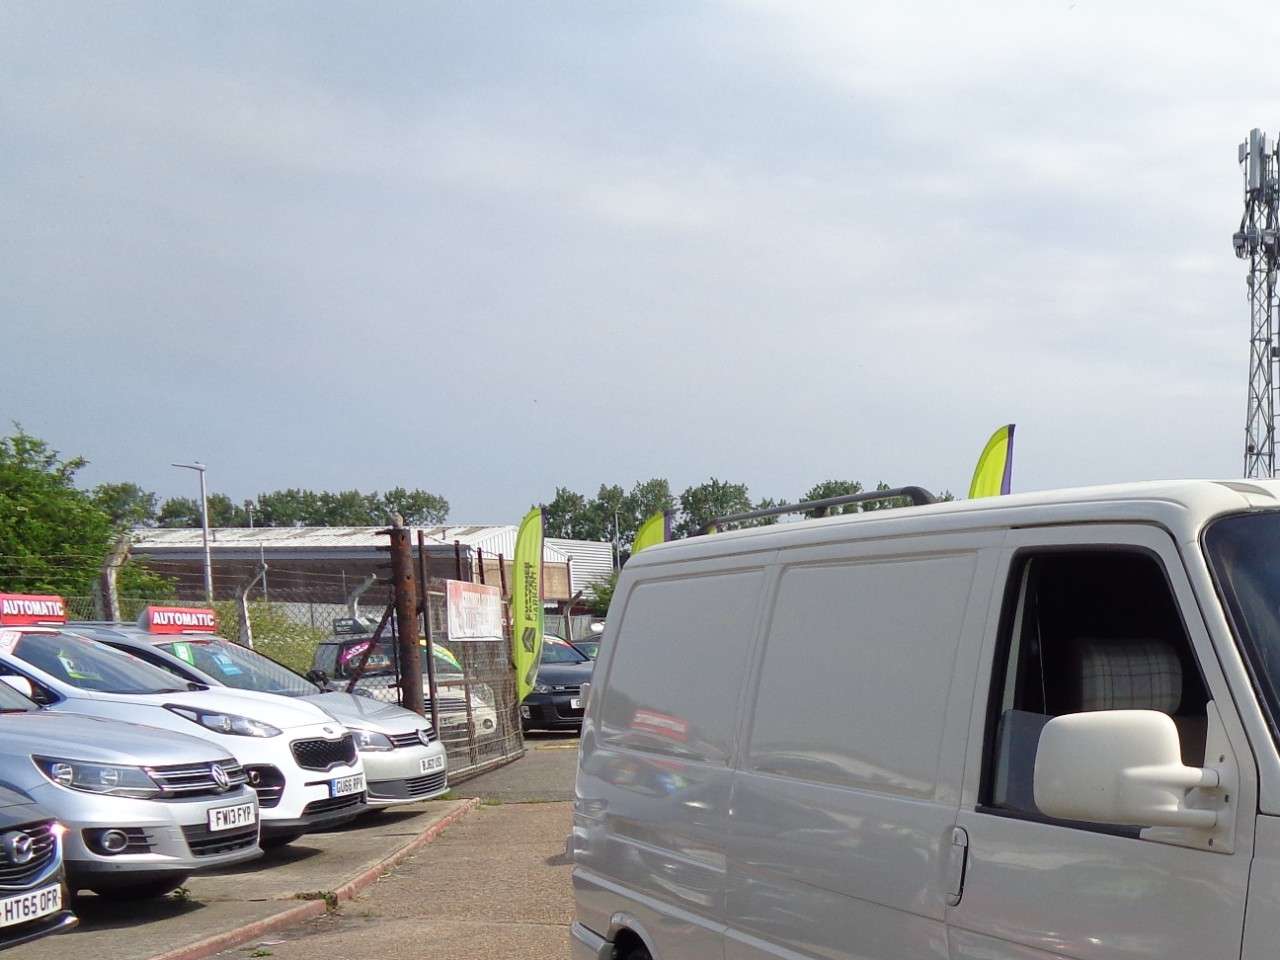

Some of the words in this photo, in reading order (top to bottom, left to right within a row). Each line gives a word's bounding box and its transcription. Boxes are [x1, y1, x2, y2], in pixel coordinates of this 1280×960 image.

[3, 599, 64, 616] AUTOMATIC
[152, 611, 215, 626] AUTOMATIC
[5, 895, 37, 922] HT65
[40, 889, 57, 911] OFR
